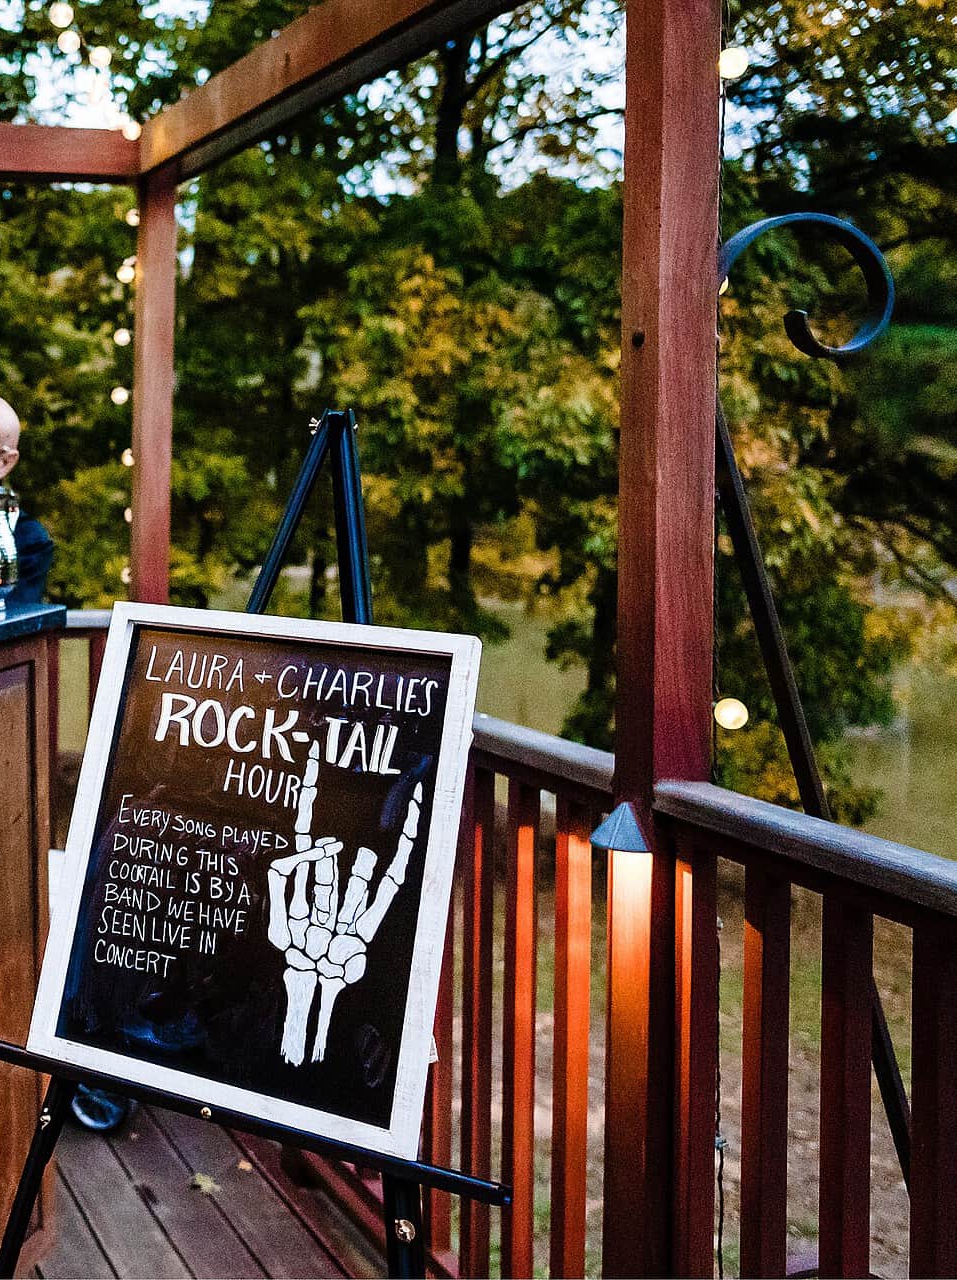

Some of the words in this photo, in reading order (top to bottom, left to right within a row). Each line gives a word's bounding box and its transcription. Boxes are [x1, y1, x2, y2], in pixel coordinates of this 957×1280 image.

[146, 646, 245, 692] LAURA
[277, 665, 439, 717] CHARLIE'S
[223, 759, 301, 810] HOUR
[113, 833, 188, 866] DURING
[196, 850, 239, 876] THIS
[172, 815, 217, 838] SONG
[221, 826, 289, 854] PLAYED
[109, 860, 176, 889] COCKTAIL
[185, 872, 201, 894] IS
[237, 882, 251, 906] A
[97, 906, 146, 942] SEEN
[151, 917, 191, 949] LIVE
[199, 930, 217, 955] IN
[105, 883, 161, 912] BAND
[168, 896, 195, 921] WE
[198, 902, 247, 933] HAVE
[94, 939, 177, 978] CONCERT
